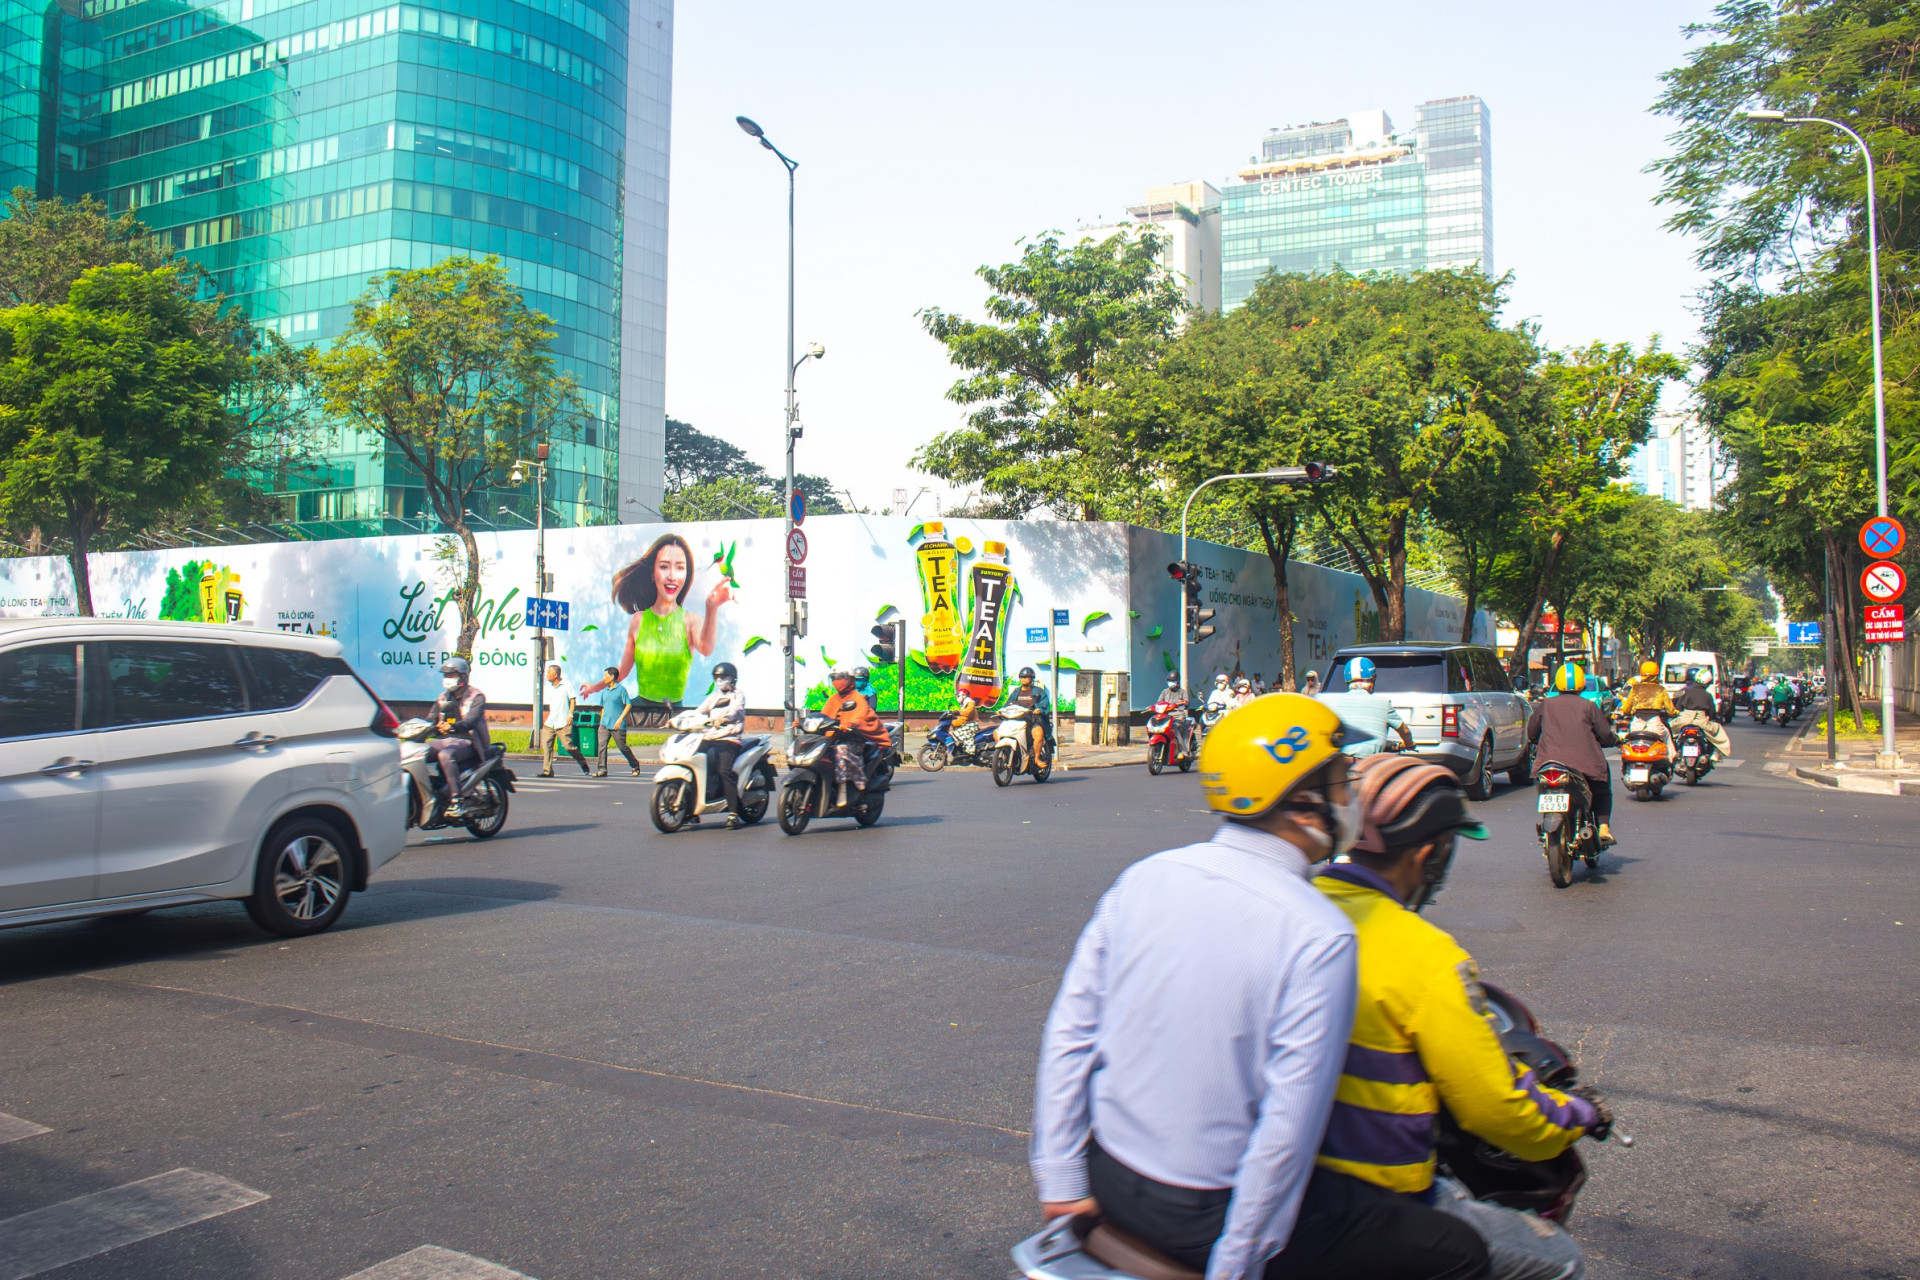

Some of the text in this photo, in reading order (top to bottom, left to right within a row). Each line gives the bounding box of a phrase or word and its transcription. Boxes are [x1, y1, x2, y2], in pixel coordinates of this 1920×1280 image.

[1260, 168, 1383, 195] CENTEC TOWER
[7, 598, 28, 607] LONG
[1229, 593, 1241, 606] CHO
[278, 612, 290, 620] TRÀ
[298, 611, 315, 620] LONG
[383, 581, 455, 643] Lướt
[1871, 607, 1896, 619] CẤM
[381, 651, 414, 666] QUA
[418, 651, 436, 669] LẸ
[479, 648, 528, 667] ĐÔNG
[970, 657, 993, 666] PLUS
